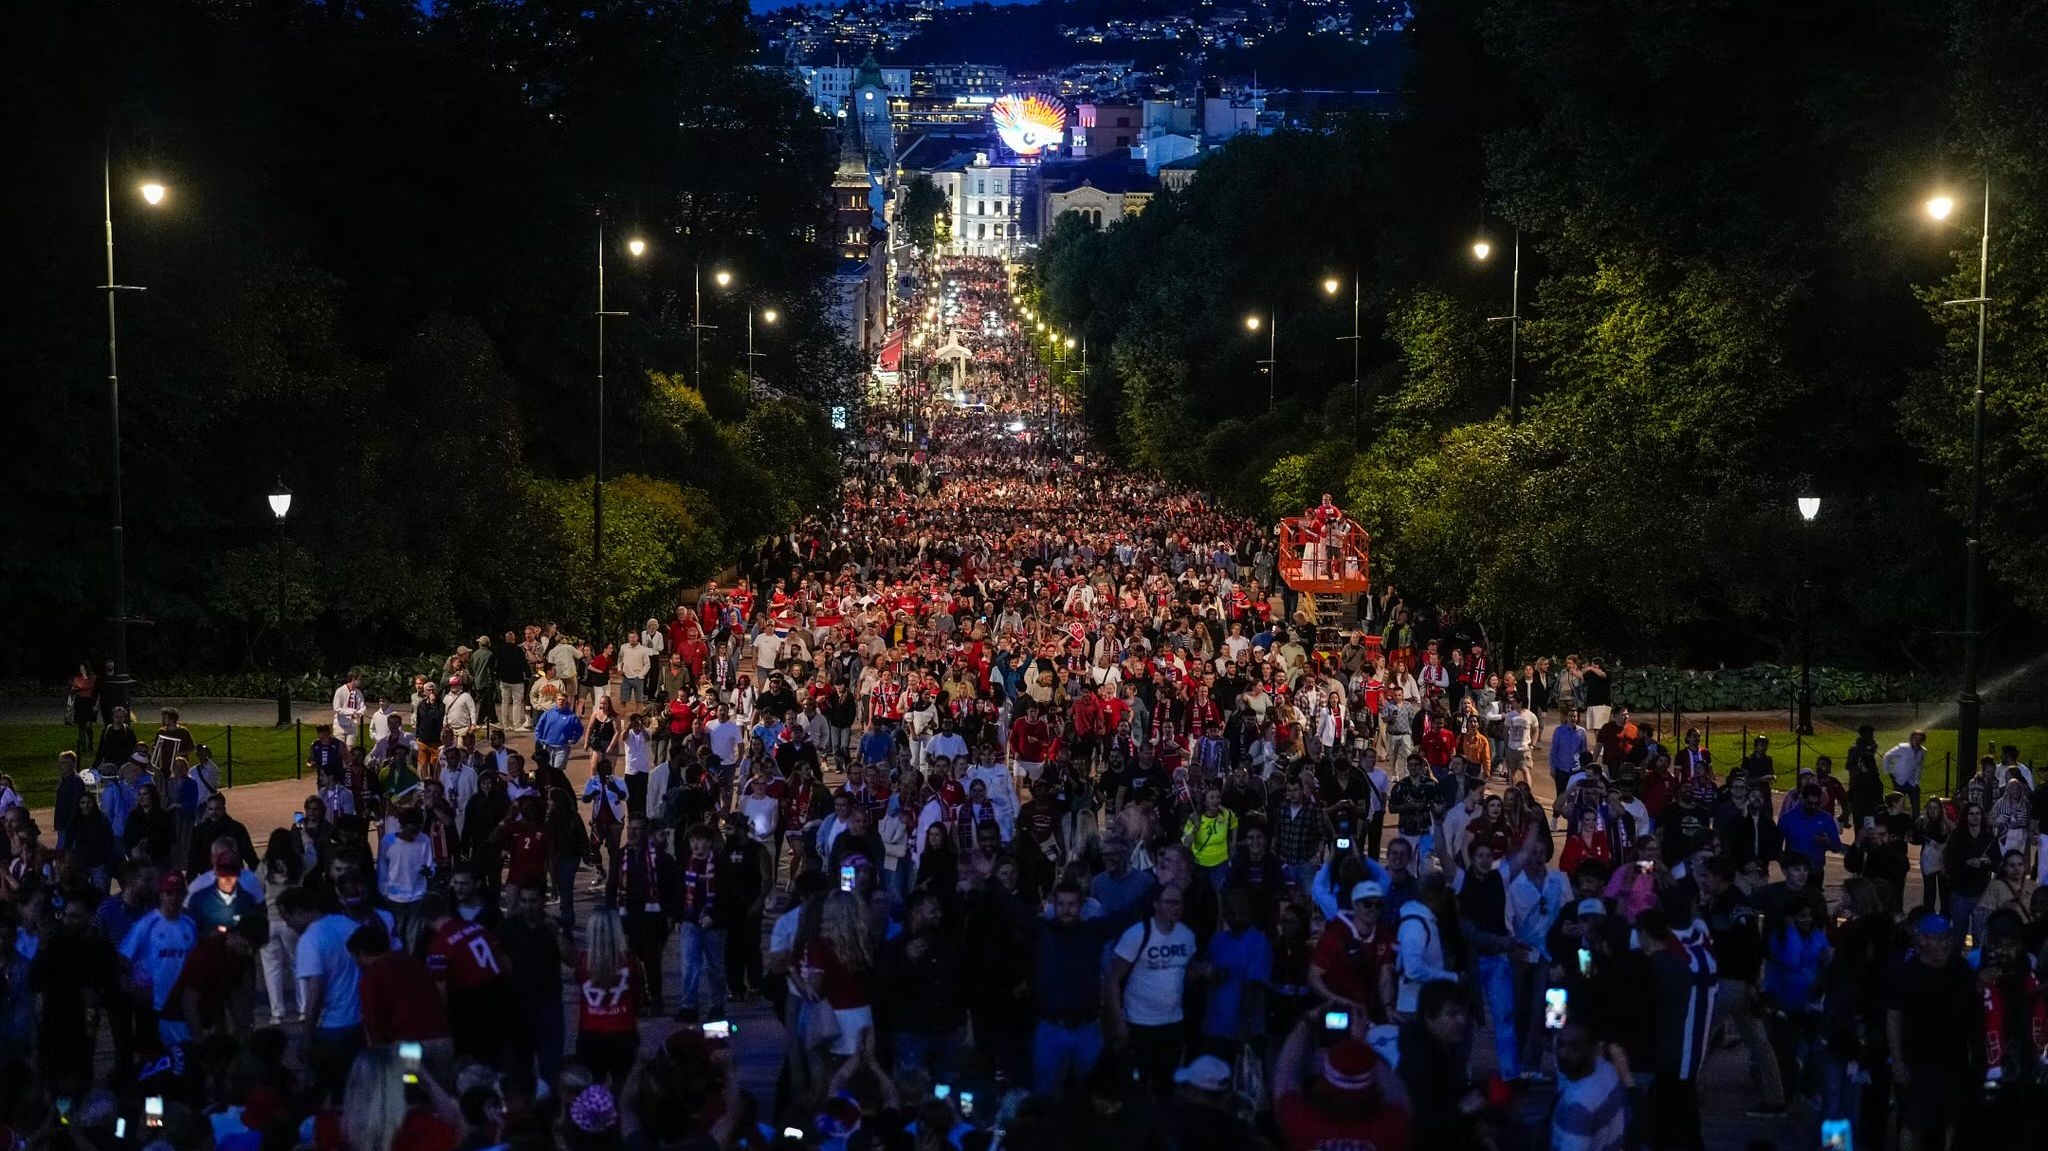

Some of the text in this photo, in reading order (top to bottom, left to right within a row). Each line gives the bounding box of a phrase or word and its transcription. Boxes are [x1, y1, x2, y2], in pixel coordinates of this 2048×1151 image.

[524, 837, 531, 849] 2
[468, 936, 501, 975] 9
[1148, 944, 1187, 958] CORE
